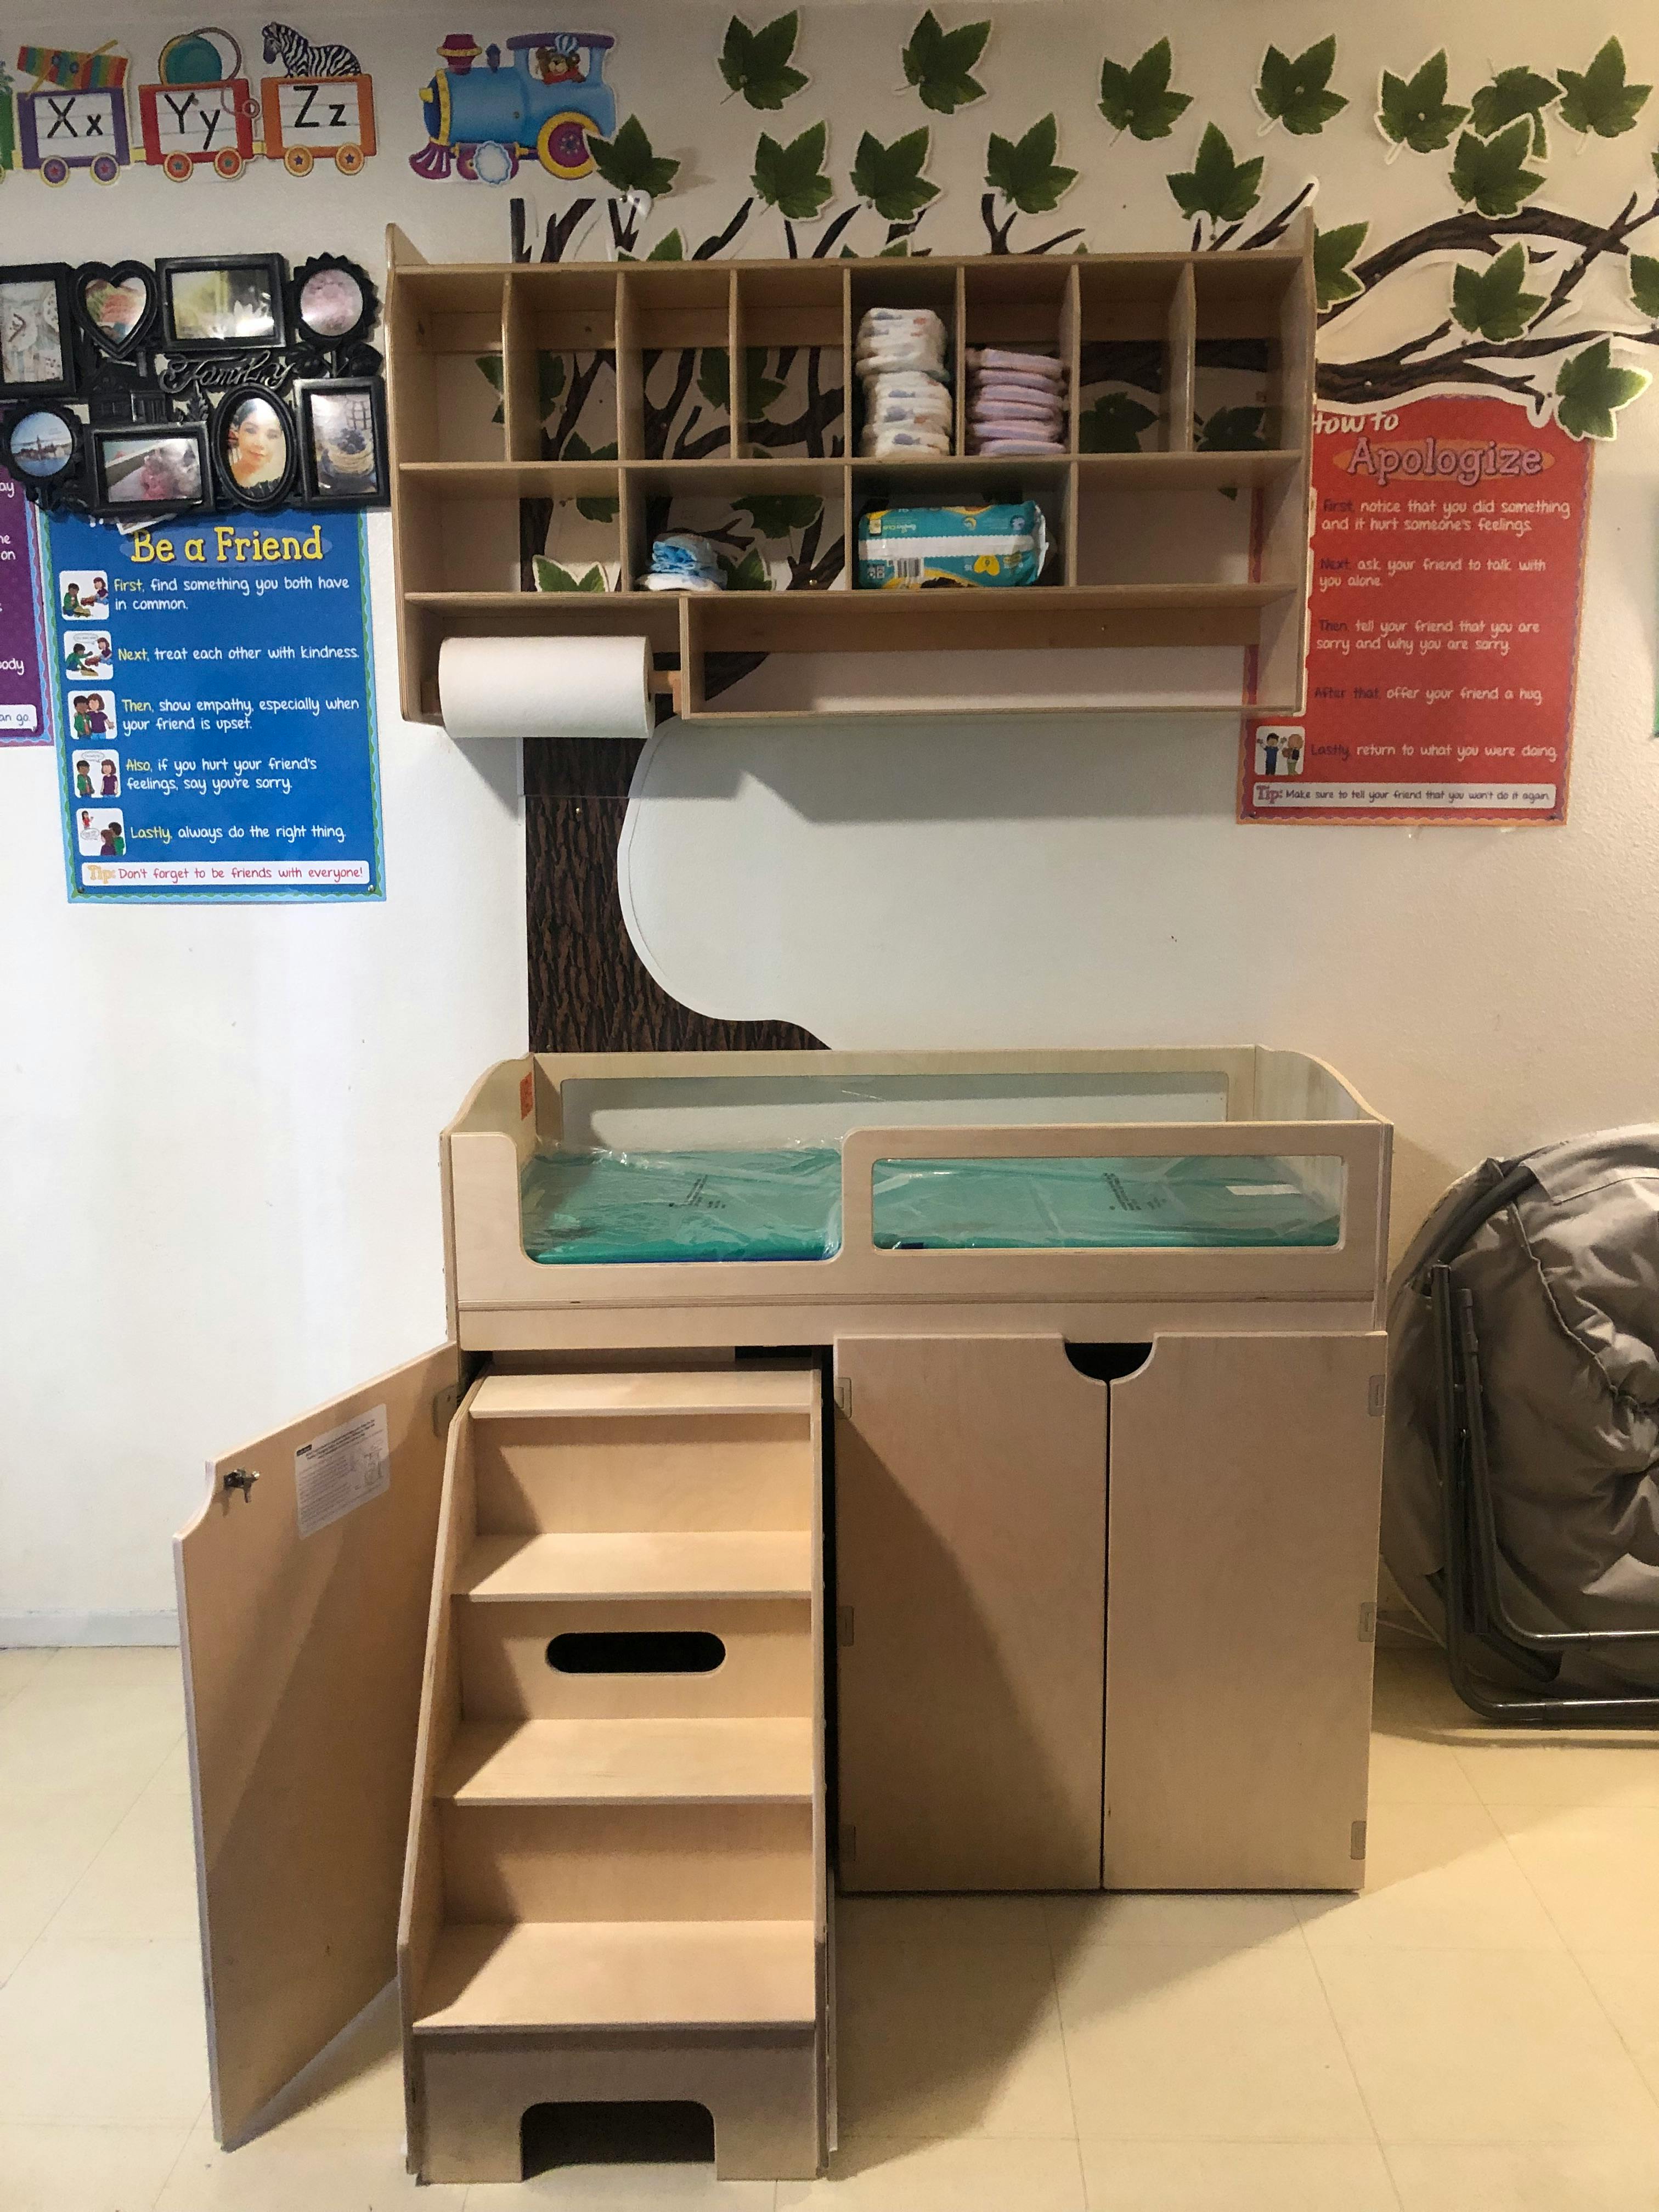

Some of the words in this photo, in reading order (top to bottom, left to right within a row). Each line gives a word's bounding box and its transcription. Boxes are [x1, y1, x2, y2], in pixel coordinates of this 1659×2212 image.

[1371, 411, 1399, 431] to
[1347, 436, 1544, 487] Apologize
[1360, 500, 1401, 512] notice
[1408, 500, 1436, 512] that
[1443, 503, 1466, 519] you
[1472, 500, 1494, 513] did
[1501, 500, 1570, 519] something
[1321, 517, 1350, 531] and
[1355, 518, 1365, 531] it
[1370, 517, 1400, 531] hurt
[1404, 518, 1471, 531] someone's
[131, 527, 174, 563] Be
[184, 539, 205, 562] a
[213, 524, 324, 563] Friend
[1358, 558, 1381, 571] ask
[1387, 560, 1416, 577] your
[1423, 557, 1463, 571] friend
[1468, 558, 1481, 571] to
[1487, 558, 1511, 571] talk
[1518, 558, 1547, 571] with
[114, 578, 145, 592] First,
[150, 577, 178, 591] find
[183, 577, 250, 596] something
[256, 579, 278, 596] you
[284, 576, 313, 590] both
[318, 575, 350, 590] have
[1319, 575, 1342, 593] you
[115, 598, 127, 610] in
[132, 599, 189, 611] common.
[1355, 619, 1374, 633] tell
[1380, 622, 1409, 637] your
[1414, 619, 1454, 633] friend
[1458, 620, 1486, 633] that
[1490, 622, 1514, 639] you
[1517, 623, 1541, 633] are
[117, 647, 150, 662] Next,
[154, 647, 188, 660] treat
[193, 646, 222, 660] each
[228, 646, 262, 659] other
[267, 646, 295, 659] with
[300, 645, 360, 659] kindness.
[1316, 638, 1350, 656] sorry
[1356, 637, 1381, 650] and
[1387, 637, 1414, 656] why
[1419, 640, 1442, 656] you
[1447, 640, 1469, 650] are
[1386, 686, 1420, 699] offer
[1425, 689, 1454, 706] your
[1460, 687, 1499, 700] friend
[1504, 689, 1514, 700] a
[121, 698, 154, 713] Then,
[159, 699, 190, 712] show
[196, 698, 254, 717] empathy,
[259, 698, 320, 716] especially
[325, 697, 359, 710] when
[122, 719, 150, 737] your
[156, 718, 195, 730] friend
[201, 718, 211, 730] is
[216, 718, 252, 733] upset.
[1357, 745, 1396, 756] return
[1402, 744, 1414, 755] to
[1420, 744, 1452, 756] what
[1457, 746, 1480, 761] you
[1485, 746, 1515, 757] were
[126, 759, 153, 773] Also,
[158, 758, 168, 772] if
[174, 760, 196, 777] you
[201, 758, 229, 771] hurt
[233, 759, 262, 776] your
[268, 758, 317, 770] friend's
[126, 777, 179, 795] feelings,
[183, 780, 207, 795] say
[212, 778, 250, 795] you're
[256, 778, 293, 795] sorry.
[1256, 785, 1283, 804] Tip:
[1286, 790, 1311, 799] Make
[1315, 791, 1334, 799] sure
[1338, 790, 1348, 799] to
[1351, 790, 1365, 799] tell
[1369, 791, 1389, 803] your
[1392, 790, 1421, 799] friend
[1425, 790, 1445, 799] that
[1448, 792, 1464, 803] you
[1469, 791, 1493, 799] won't
[1497, 791, 1508, 799] do
[1511, 791, 1519, 799] it
[130, 826, 173, 844] Lastly,
[178, 825, 223, 844] always
[228, 825, 245, 838] do
[249, 824, 270, 838] the
[275, 824, 307, 843] right
[311, 824, 346, 843] thing.
[87, 865, 116, 885] Tip:
[117, 868, 148, 879] Don't
[153, 868, 189, 884] forget
[194, 867, 206, 879] to
[212, 867, 225, 879] be
[232, 867, 272, 879] friends
[278, 867, 302, 879] with
[308, 866, 363, 883] everyone!
